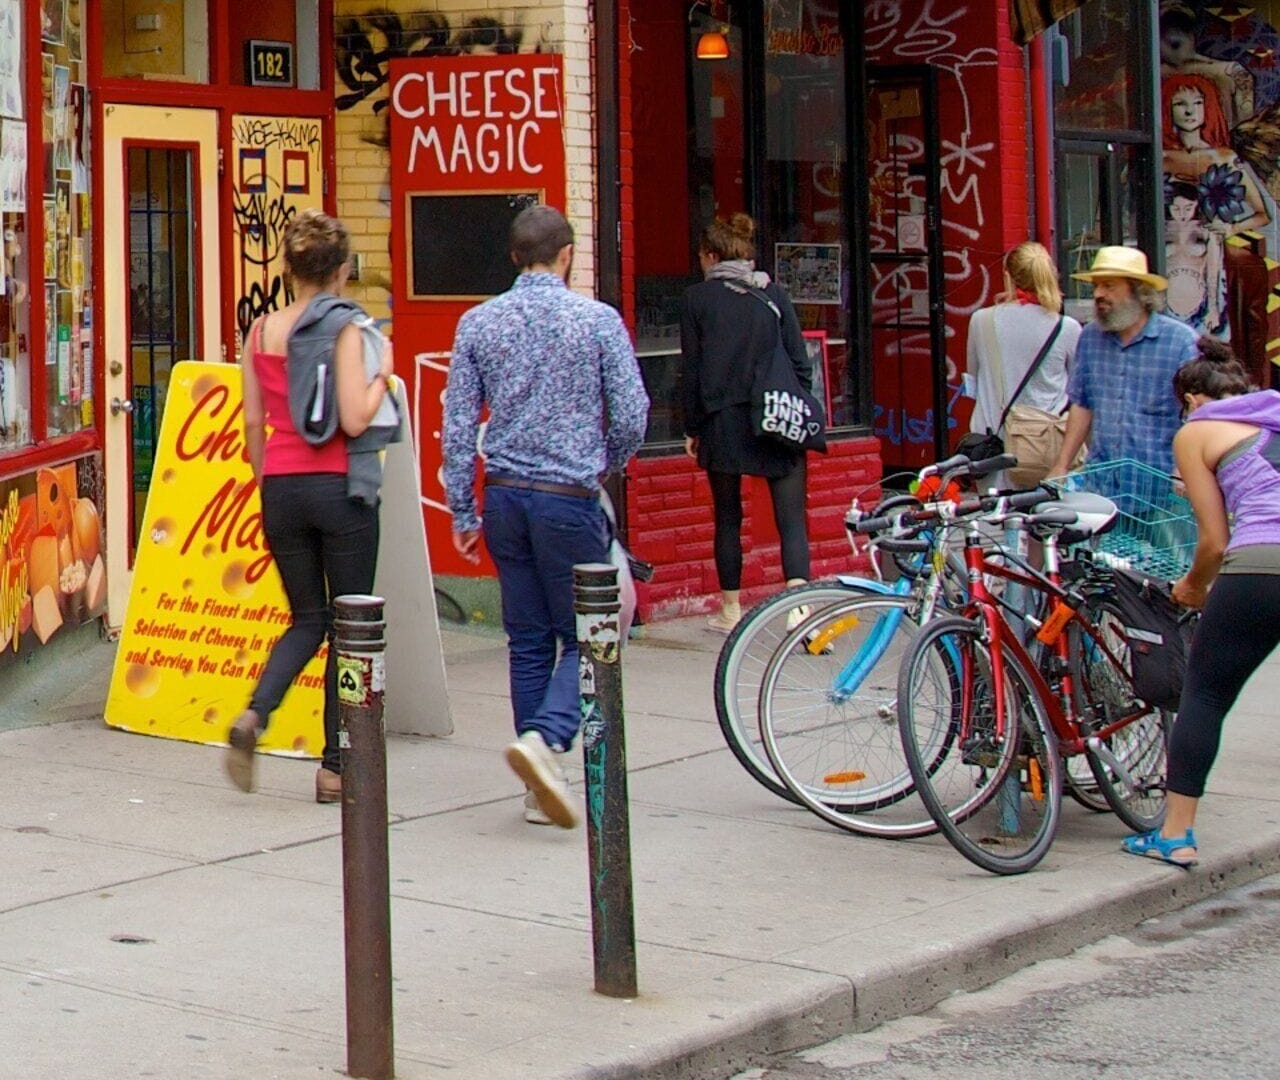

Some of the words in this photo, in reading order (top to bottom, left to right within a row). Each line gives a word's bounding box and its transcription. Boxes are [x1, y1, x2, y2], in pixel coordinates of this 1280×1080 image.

[258, 52, 283, 76] 182
[393, 68, 558, 119] CHEESE
[408, 121, 543, 173] MAGIC
[762, 417, 808, 443] GABI
[764, 405, 803, 426] UND
[157, 592, 181, 611] For
[181, 593, 200, 613] the
[201, 597, 240, 619] Finest
[241, 603, 266, 622] and
[134, 619, 187, 641] Selection
[189, 624, 204, 643] of
[205, 628, 247, 649] Cheese
[250, 634, 264, 651] in
[125, 646, 147, 664] and
[150, 650, 194, 671] Service
[196, 655, 216, 675] You
[220, 658, 245, 678] Can
